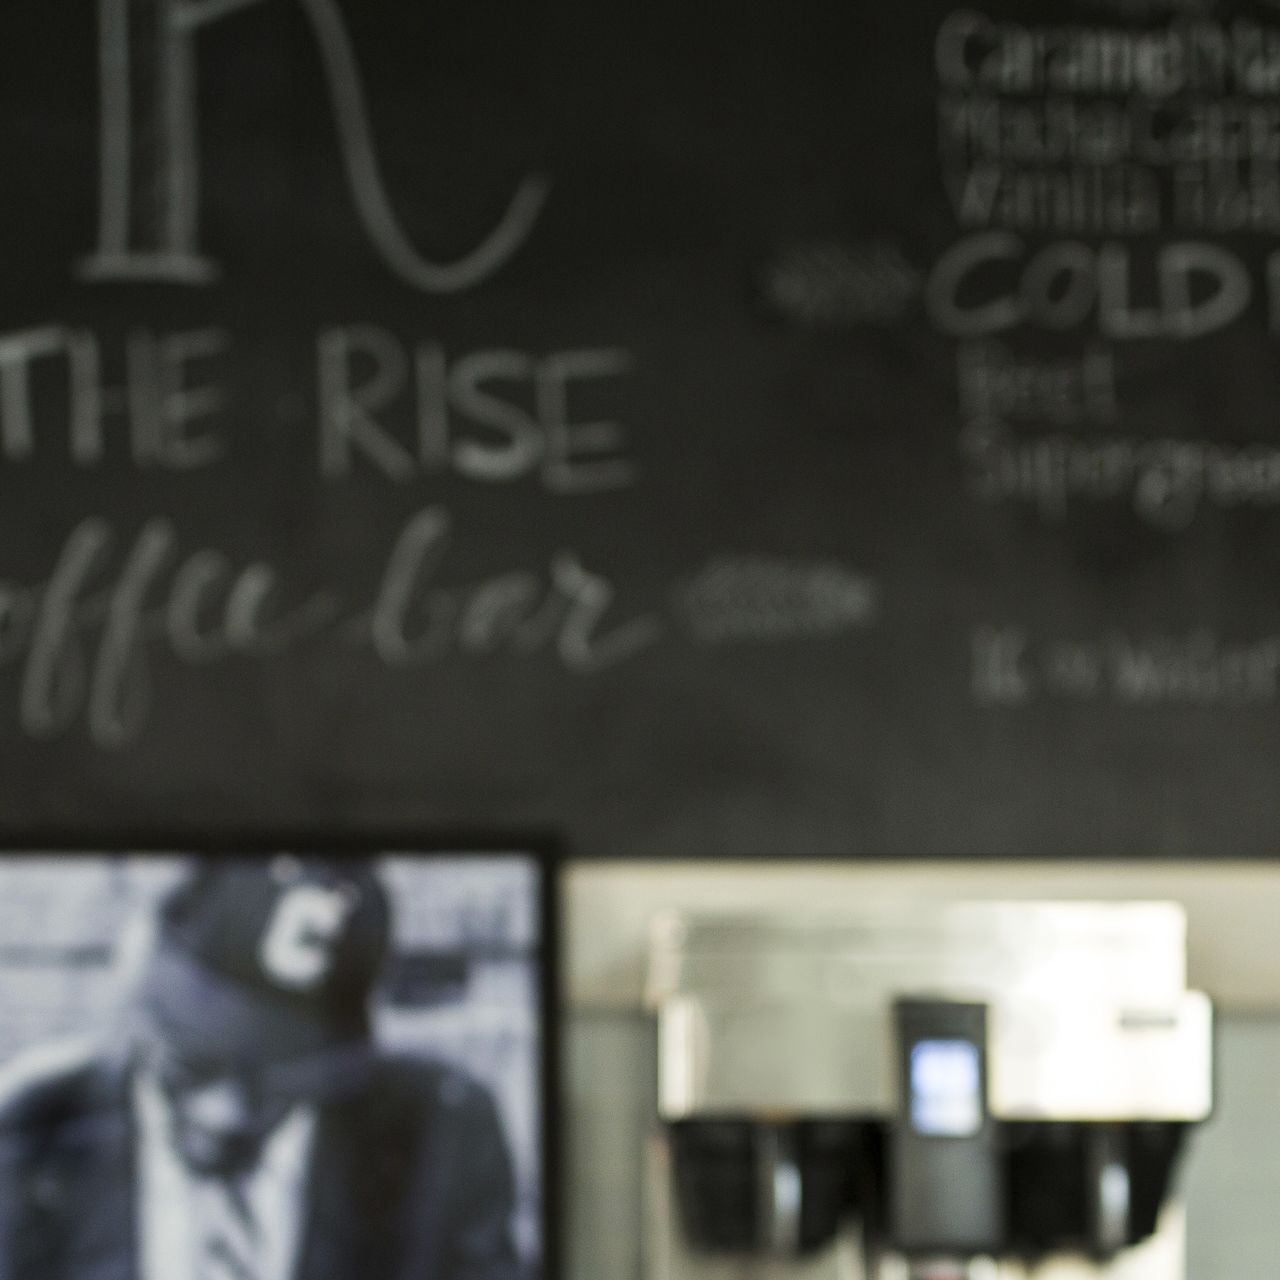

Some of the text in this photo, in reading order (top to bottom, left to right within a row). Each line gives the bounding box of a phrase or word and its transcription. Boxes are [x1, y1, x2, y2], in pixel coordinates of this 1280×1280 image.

[927, 231, 1252, 338] COLD
[320, 323, 636, 494] RISE
[350, 505, 665, 673] bar
